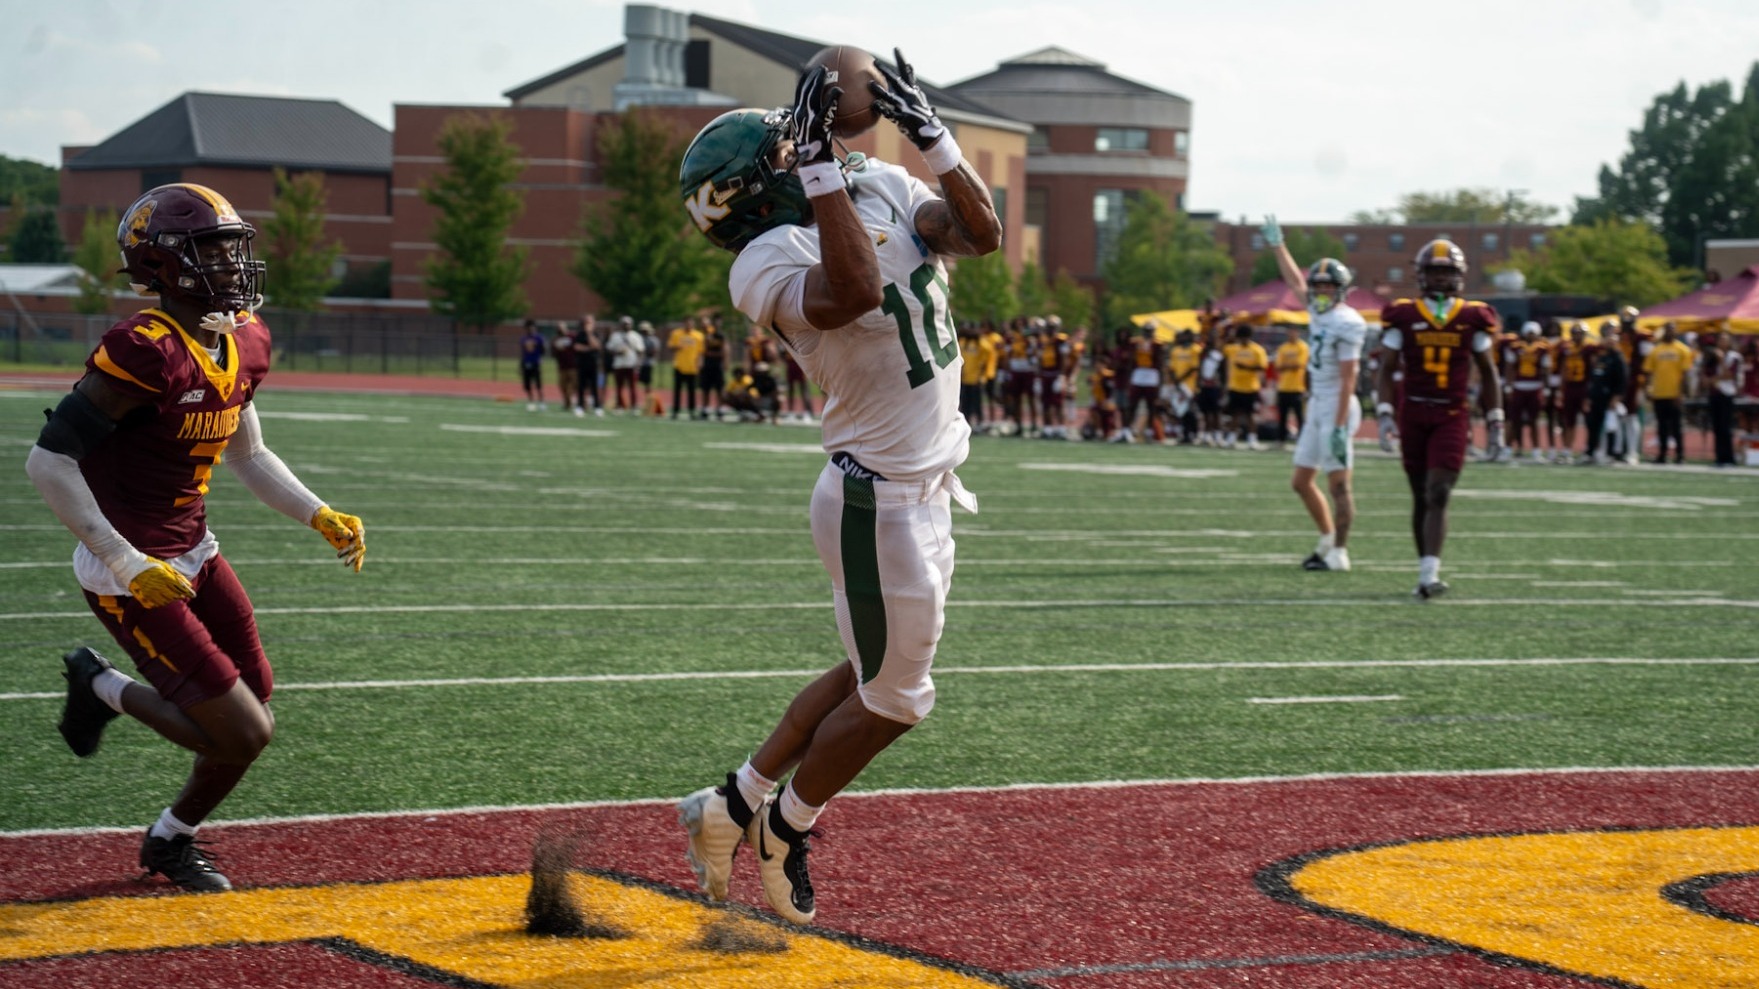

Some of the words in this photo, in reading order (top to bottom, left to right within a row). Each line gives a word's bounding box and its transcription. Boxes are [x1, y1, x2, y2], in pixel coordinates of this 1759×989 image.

[685, 179, 732, 233] K
[882, 261, 959, 390] 10
[1424, 346, 1451, 390] 4
[838, 455, 879, 481] NIK
